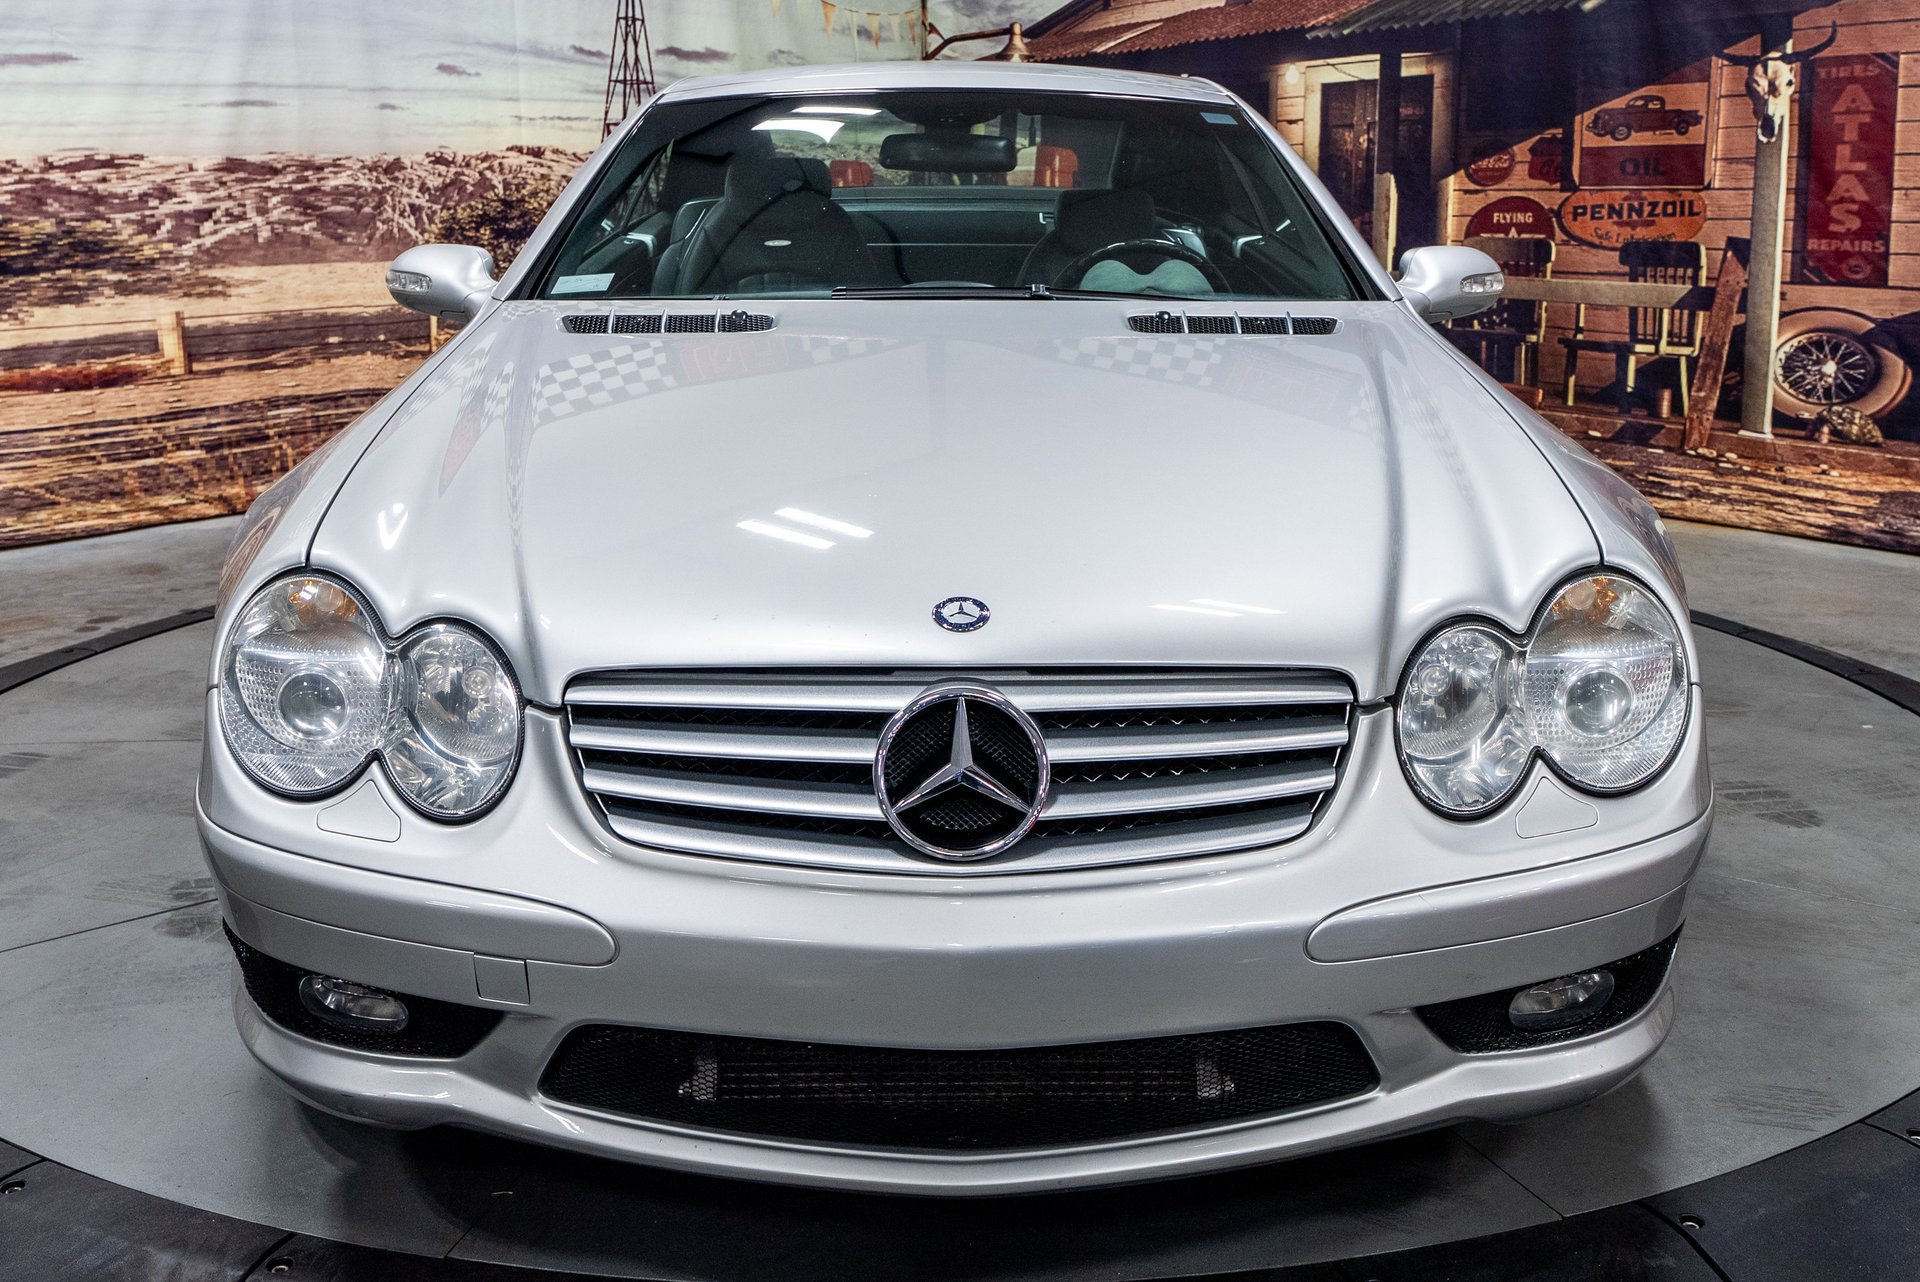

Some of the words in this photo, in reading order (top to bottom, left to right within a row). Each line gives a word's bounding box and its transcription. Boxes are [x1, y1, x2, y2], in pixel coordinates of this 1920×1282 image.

[1817, 65, 1880, 79] TIRES
[1619, 157, 1667, 177] OIL
[1826, 84, 1875, 233] ATLAS
[1493, 212, 1533, 224] FLYING
[1572, 199, 1701, 222] PENNZOIL
[1807, 238, 1886, 254] REPAIRS
